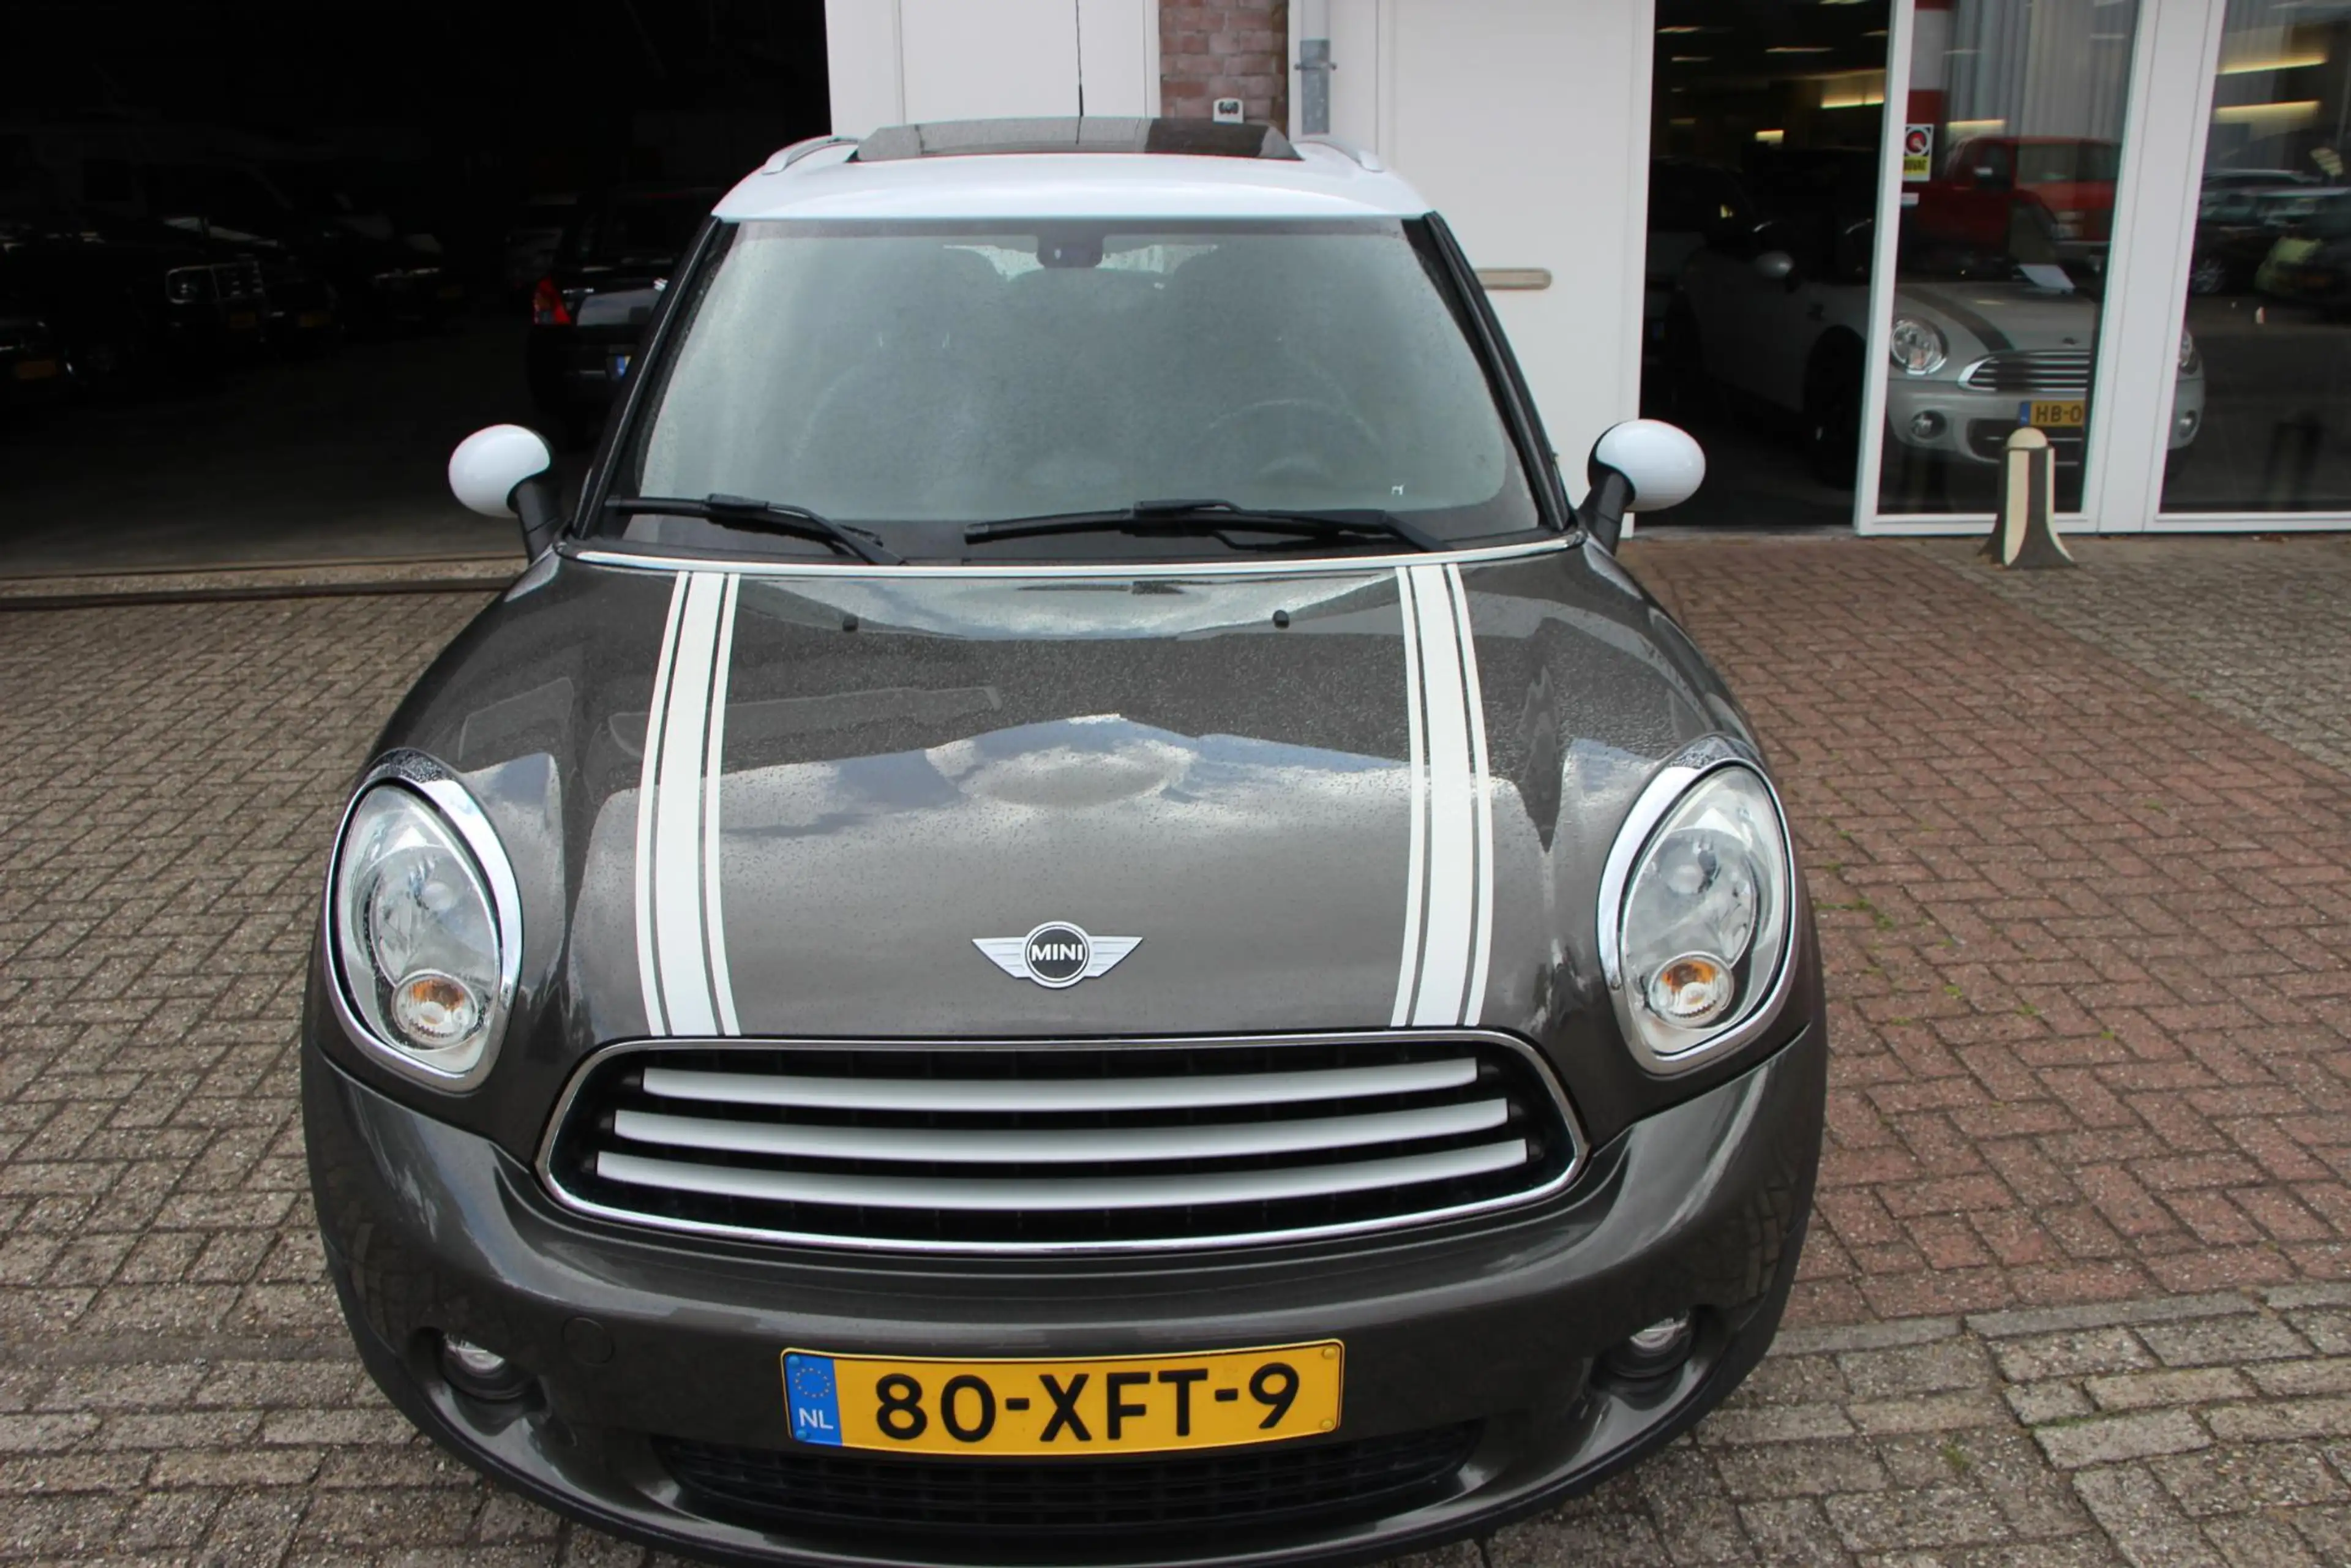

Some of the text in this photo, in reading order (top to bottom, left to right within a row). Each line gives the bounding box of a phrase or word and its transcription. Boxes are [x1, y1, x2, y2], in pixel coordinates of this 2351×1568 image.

[1031, 943, 1083, 961] MINI
[875, 1361, 1300, 1442] 80-XFT-9
[798, 1407, 833, 1430] NL
